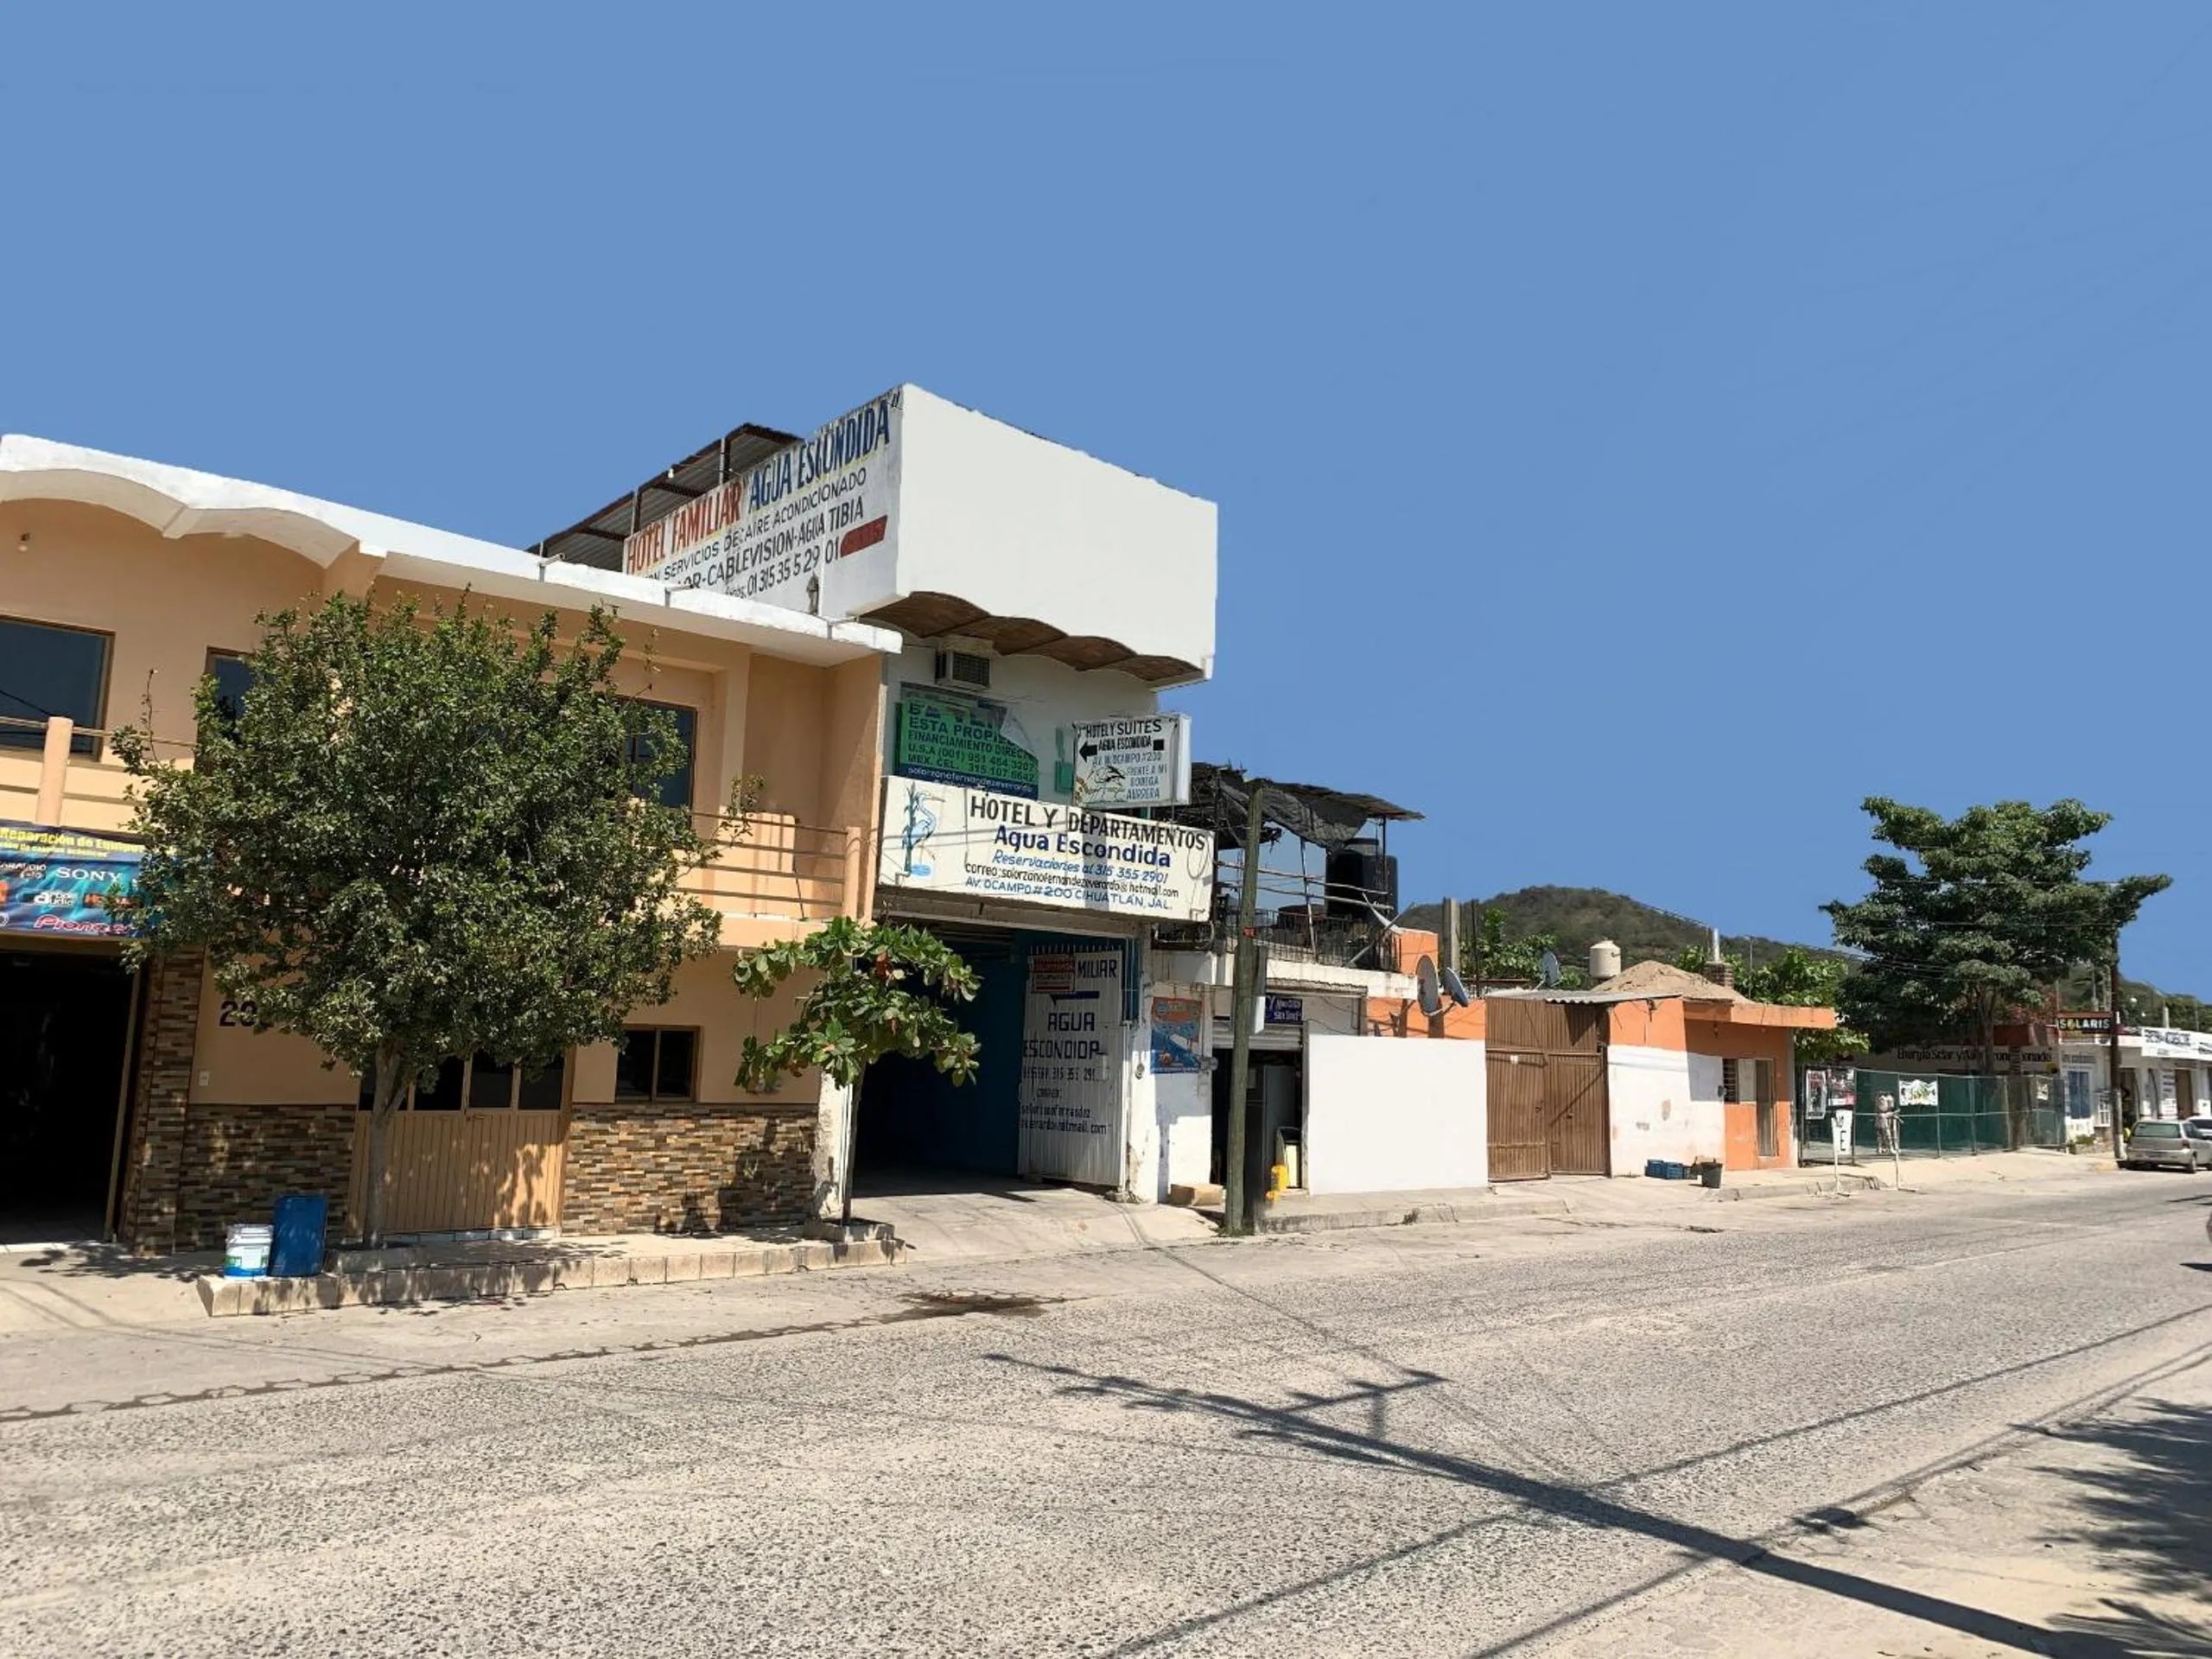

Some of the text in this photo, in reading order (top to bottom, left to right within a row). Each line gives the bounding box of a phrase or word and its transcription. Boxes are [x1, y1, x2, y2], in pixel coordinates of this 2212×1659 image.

[664, 541, 720, 581] SERVICIOS
[745, 514, 771, 542] AIRE
[772, 467, 868, 529] ACONDICIONADO
[829, 495, 864, 532] TIBIA
[627, 521, 665, 575] HOTEL
[671, 482, 742, 554] FAMILIAR
[909, 715, 948, 734] ESTA
[1116, 718, 1162, 735] SUITES
[908, 729, 993, 753] FINANCIAMIENTO
[970, 795, 1206, 850] HOTEL Y DEPARTAMENTOS
[1057, 833, 1171, 868] Escondida
[54, 867, 121, 882] SONY
[992, 849, 1080, 873] Reservaciones
[1095, 863, 1114, 876] 315
[1116, 867, 1140, 880] 355
[219, 1001, 266, 1027] 20
[1047, 1012, 1095, 1032] AGUA
[2059, 1018, 2110, 1029] SOLARIS
